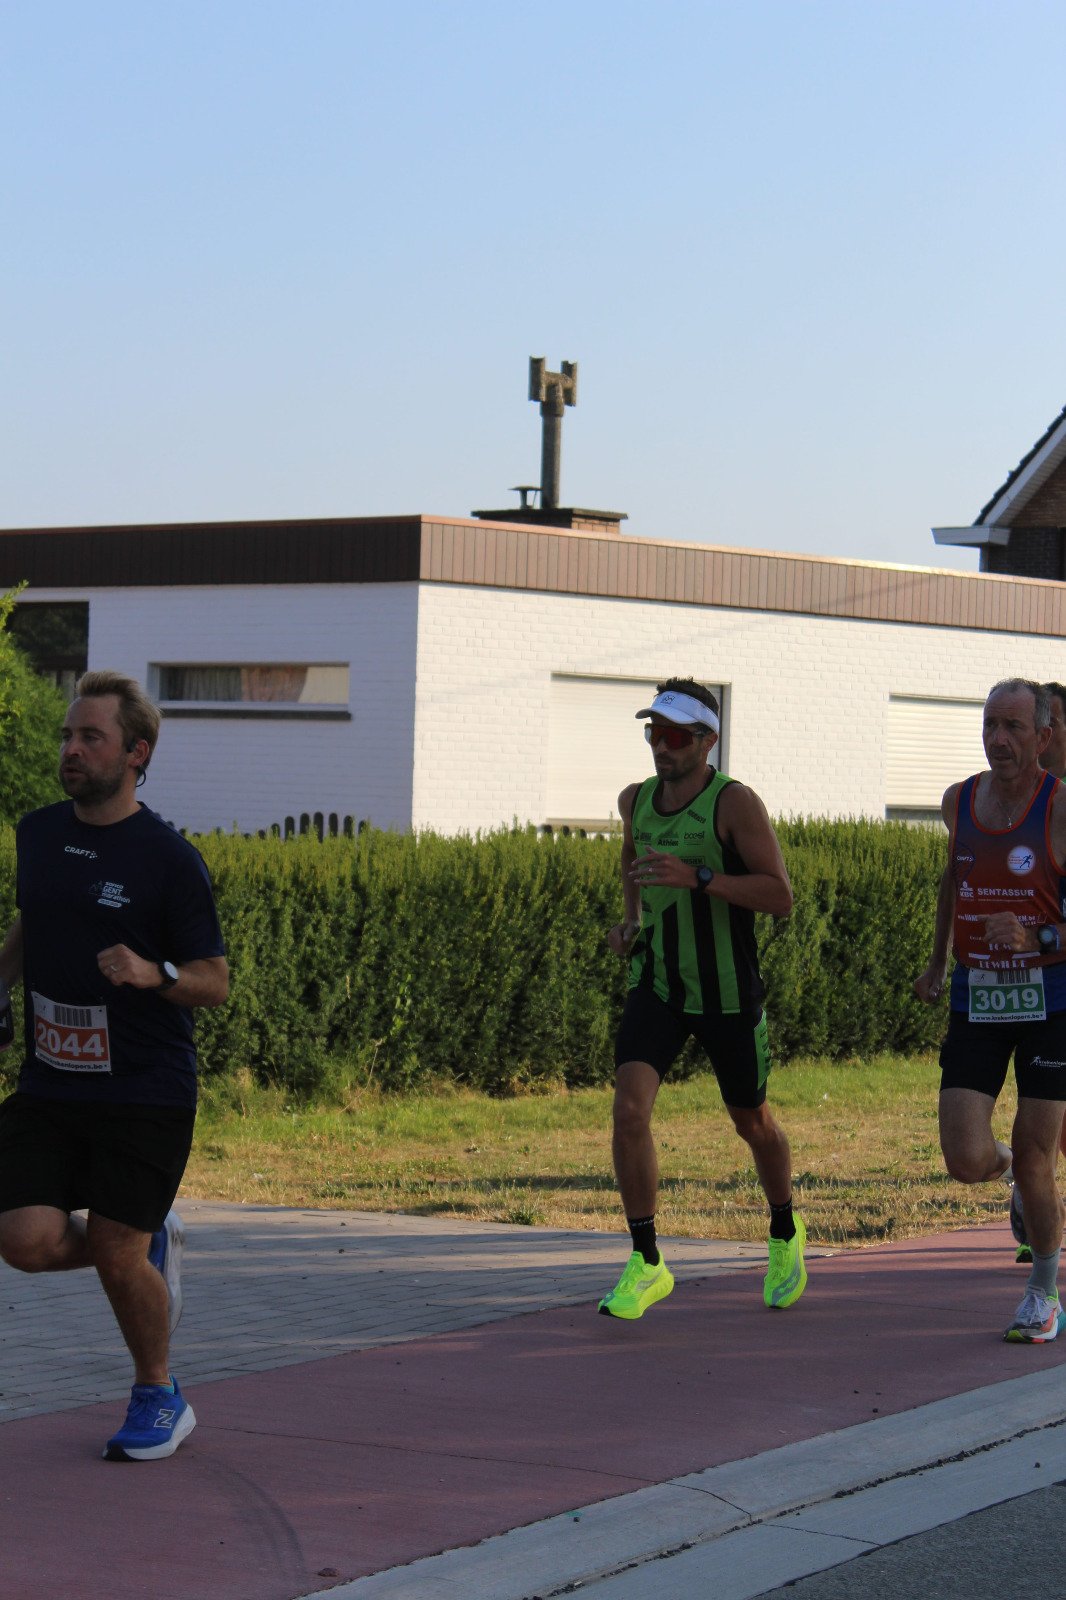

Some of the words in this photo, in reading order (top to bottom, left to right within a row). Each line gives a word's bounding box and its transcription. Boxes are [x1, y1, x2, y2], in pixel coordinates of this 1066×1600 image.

[64, 845, 90, 857] CRAFT
[103, 886, 122, 896] GENT
[977, 887, 1034, 898] SENTASSUR
[975, 988, 1039, 1011] 3019
[36, 1022, 105, 1057] 2044
